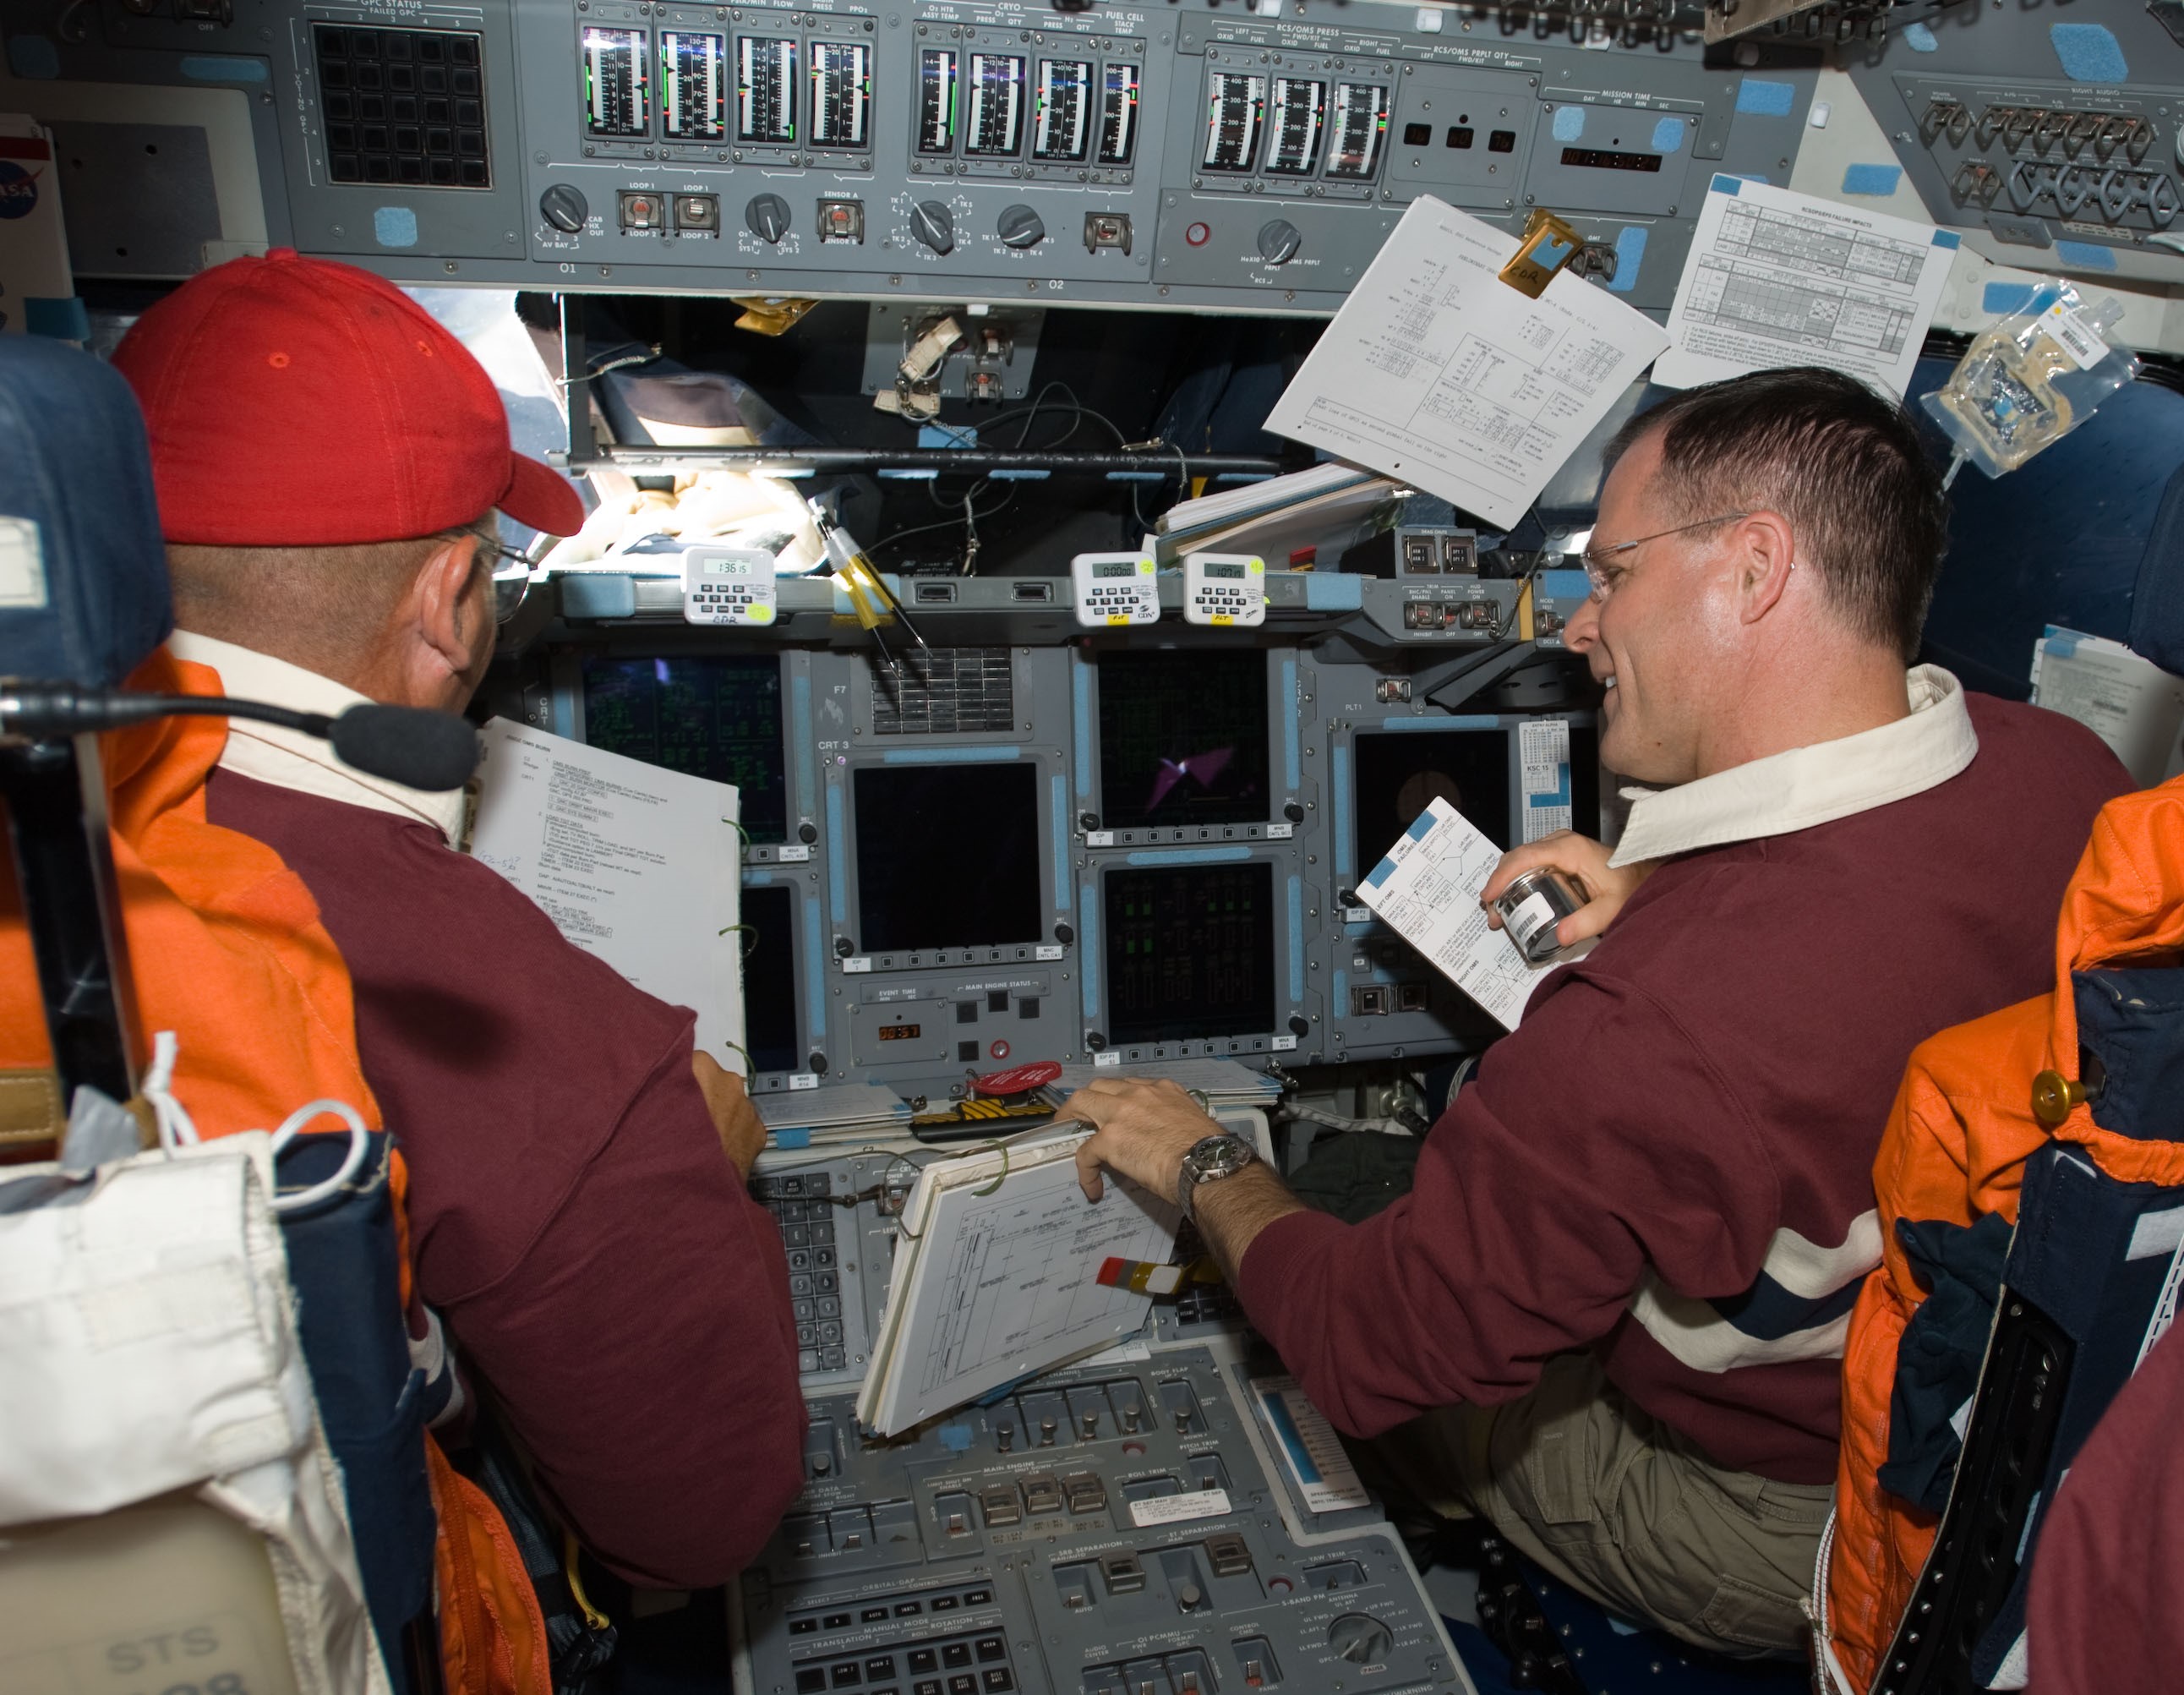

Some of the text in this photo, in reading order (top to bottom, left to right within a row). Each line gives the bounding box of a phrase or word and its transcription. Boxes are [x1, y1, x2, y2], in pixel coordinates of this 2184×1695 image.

[385, 0, 423, 9] STATUS
[812, 3, 833, 11] PRESS
[998, 3, 1021, 11] CRYO
[369, 7, 416, 17] FAILED GPC
[976, 14, 996, 24] PRESS
[1007, 18, 1022, 26] QTY
[1125, 14, 1144, 22] CELL
[1043, 20, 1063, 29] PRESS
[1076, 23, 1090, 31] QTY
[1277, 24, 1340, 36] RCS/OMS PRESS
[1433, 46, 1509, 60] RCS/OMS PRPLT QTY
[1602, 90, 1651, 101] MISSION TIME
[1832, 214, 1852, 223] FAILURE
[1853, 219, 1873, 228] IMPACTS
[1510, 266, 1538, 284] CDR
[713, 615, 738, 624] CDR
[834, 686, 846, 694] F7
[818, 741, 849, 749] CRT 3
[1396, 843, 1407, 855] OMS
[1397, 841, 1417, 863] FAILURES
[1375, 889, 1395, 911] LEFT OMS
[1458, 960, 1479, 984] RIGHT OMS
[1048, 1369, 1082, 1378] CHANNEL
[983, 1461, 1035, 1474] MAIN ENGINE
[1179, 1524, 1226, 1535] SEPARATION
[1075, 1540, 1123, 1554] SEPARATION
[1050, 1552, 1086, 1562] MAN/AUTO
[1309, 1550, 1346, 1563] YAW TRIM
[861, 1577, 916, 1592] ORBITAL-DAP
[908, 1579, 940, 1589] CONTROL
[807, 1597, 830, 1605] SELECT
[1280, 1593, 1326, 1607] S-BAND PM
[1328, 1593, 1359, 1604] ANTENNA
[1074, 1605, 1093, 1615] AUTO
[864, 1618, 929, 1634] MANUAL MODE
[931, 1617, 973, 1629] ROTATION
[1229, 1622, 1260, 1632] CONTROL
[811, 1633, 872, 1649] TRANSLATION
[1149, 1630, 1181, 1642] PCMMU
[1168, 1634, 1195, 1643] FORMAT
[106, 1625, 220, 1675] STS
[1084, 1644, 1106, 1653] AUDIO
[1084, 1650, 1110, 1659] CENTER
